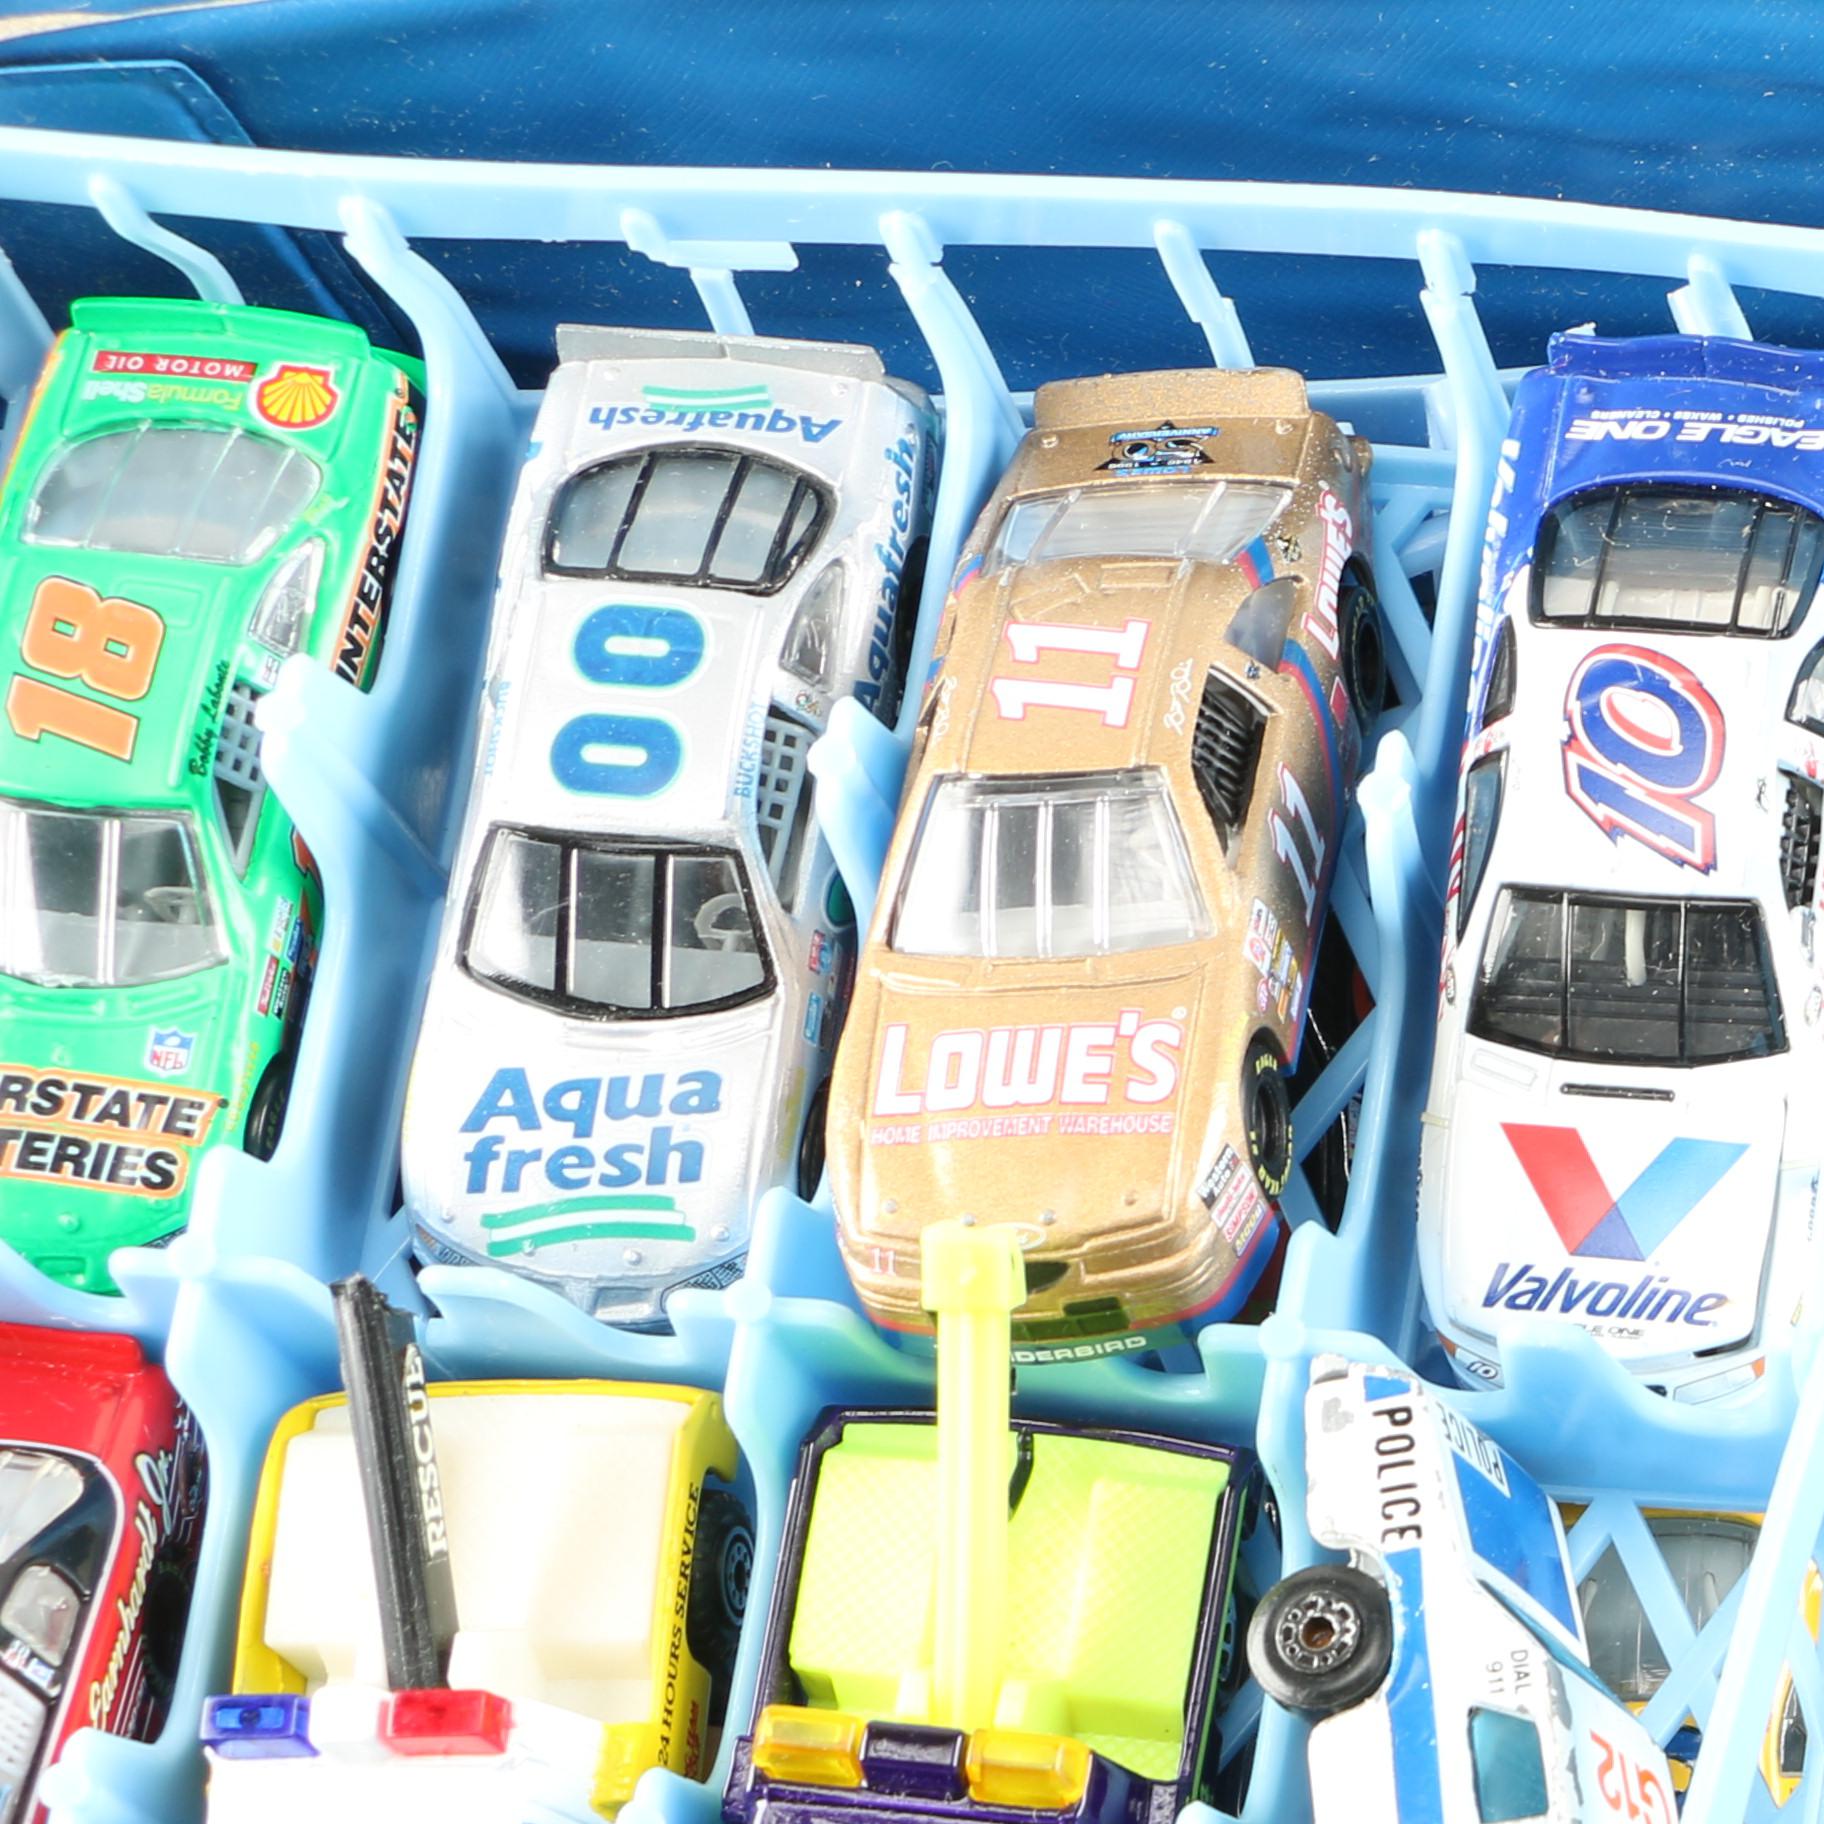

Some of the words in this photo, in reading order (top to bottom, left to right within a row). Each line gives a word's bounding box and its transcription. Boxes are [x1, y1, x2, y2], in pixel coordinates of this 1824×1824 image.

[102, 353, 143, 374] OIL
[150, 356, 246, 379] MOTOR
[589, 404, 842, 441] Aquafresh
[1565, 418, 1672, 442] ONE
[1591, 410, 1659, 421] CLEANERS
[1673, 411, 1725, 423] WAXES
[1737, 413, 1805, 428] POLISHES
[334, 423, 417, 692] INTERSTATE
[859, 435, 918, 708] Aquafresh
[7, 576, 166, 763] 18
[550, 603, 706, 798] 00
[991, 617, 1151, 729] 11
[734, 698, 769, 798] BUCKSHOT
[1561, 643, 1725, 876] 10
[1266, 760, 1325, 927] 11
[152, 1048, 183, 1072] NFL
[873, 1008, 1183, 1116] LOWE'S
[459, 1067, 723, 1139] Aqua
[870, 1123, 921, 1145] HOME
[927, 1115, 1050, 1142] IMPROVEMENT
[1058, 1113, 1174, 1137] WAREHOUSE
[464, 1126, 704, 1195] fresh
[1212, 1170, 1231, 1197] Auto
[870, 1245, 897, 1276] 11
[1481, 1262, 1730, 1326] Valvoline
[1467, 1360, 1500, 1381] 10
[405, 1345, 448, 1558] RESCUE
[1371, 1406, 1422, 1545] POLICE
[1440, 1404, 1509, 1497] POLICE
[675, 1484, 701, 1619] SERVICE
[89, 1502, 157, 1724] Earnhardt
[660, 1624, 683, 1720] HOURS
[1485, 1660, 1504, 1696] 911
[1511, 1649, 1528, 1694] DIAL
[657, 1730, 673, 1768] 24
